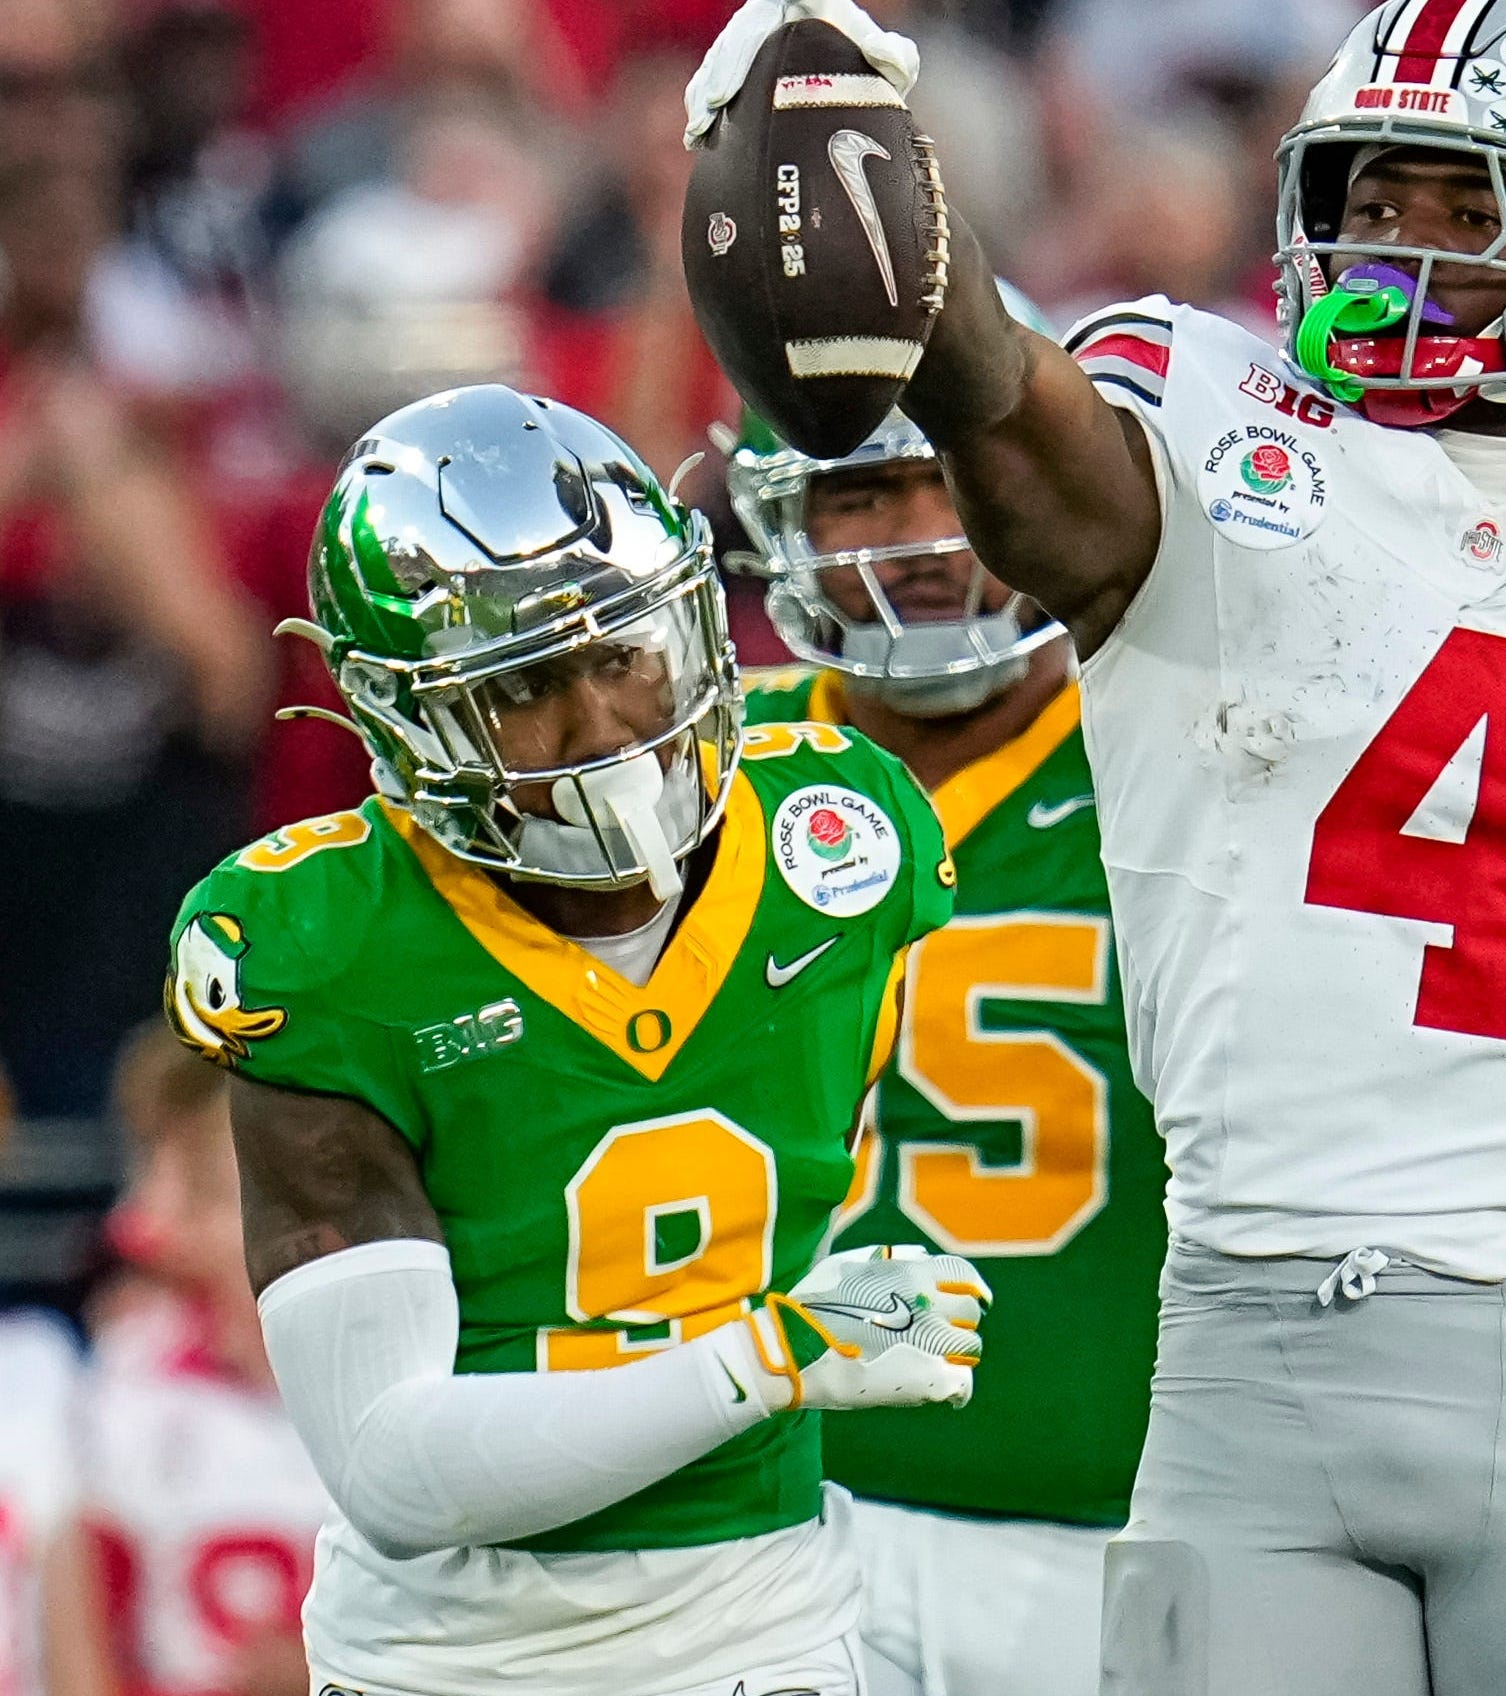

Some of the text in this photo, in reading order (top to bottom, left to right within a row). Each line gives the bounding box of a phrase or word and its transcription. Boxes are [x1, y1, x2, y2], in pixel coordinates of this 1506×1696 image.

[1398, 89, 1451, 113] STATE
[1205, 426, 1325, 507] ROSE BOWL GAME
[1231, 490, 1290, 514] presented by
[1233, 509, 1300, 538] Prudential
[235, 809, 372, 872] 9
[781, 792, 889, 871] ROSE BOWL GAME
[831, 869, 889, 898] Prudential
[537, 1107, 777, 1373] 9
